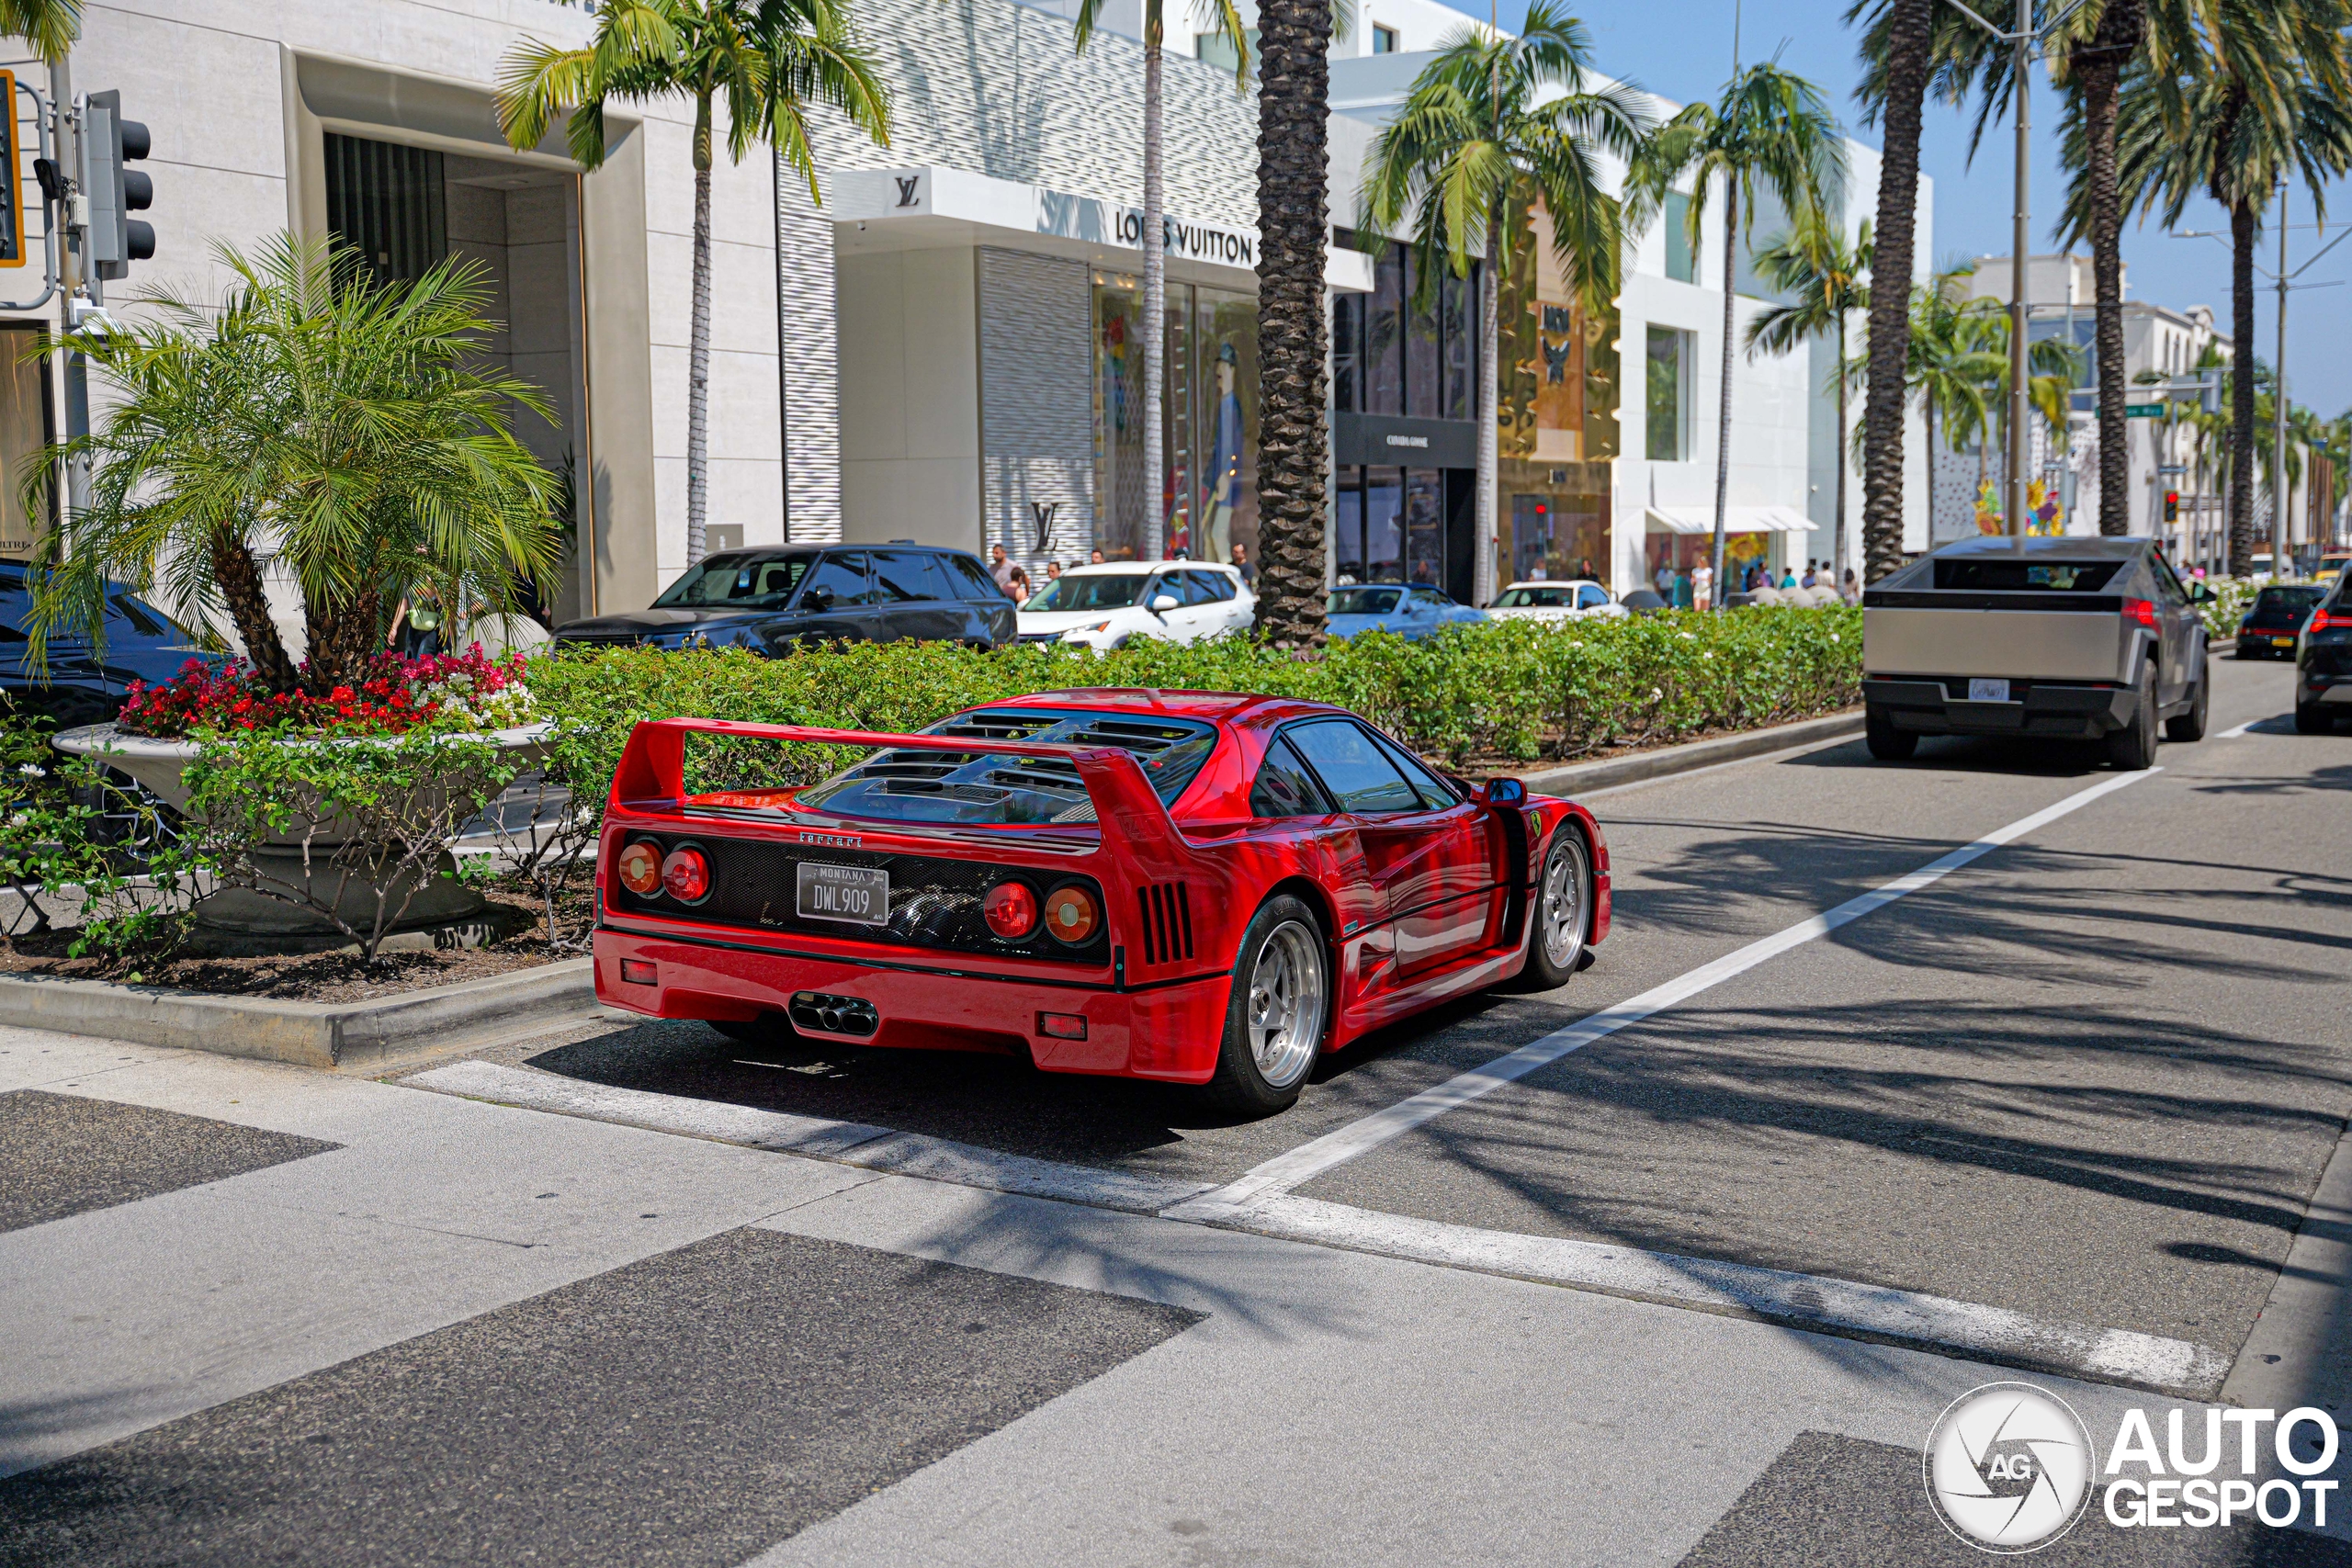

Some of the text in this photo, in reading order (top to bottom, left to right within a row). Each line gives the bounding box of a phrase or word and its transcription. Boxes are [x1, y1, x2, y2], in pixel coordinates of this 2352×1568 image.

[1116, 211, 1251, 264] LOS VUITTON
[799, 832, 862, 847] Ferrari
[820, 867, 865, 882] MONTANA
